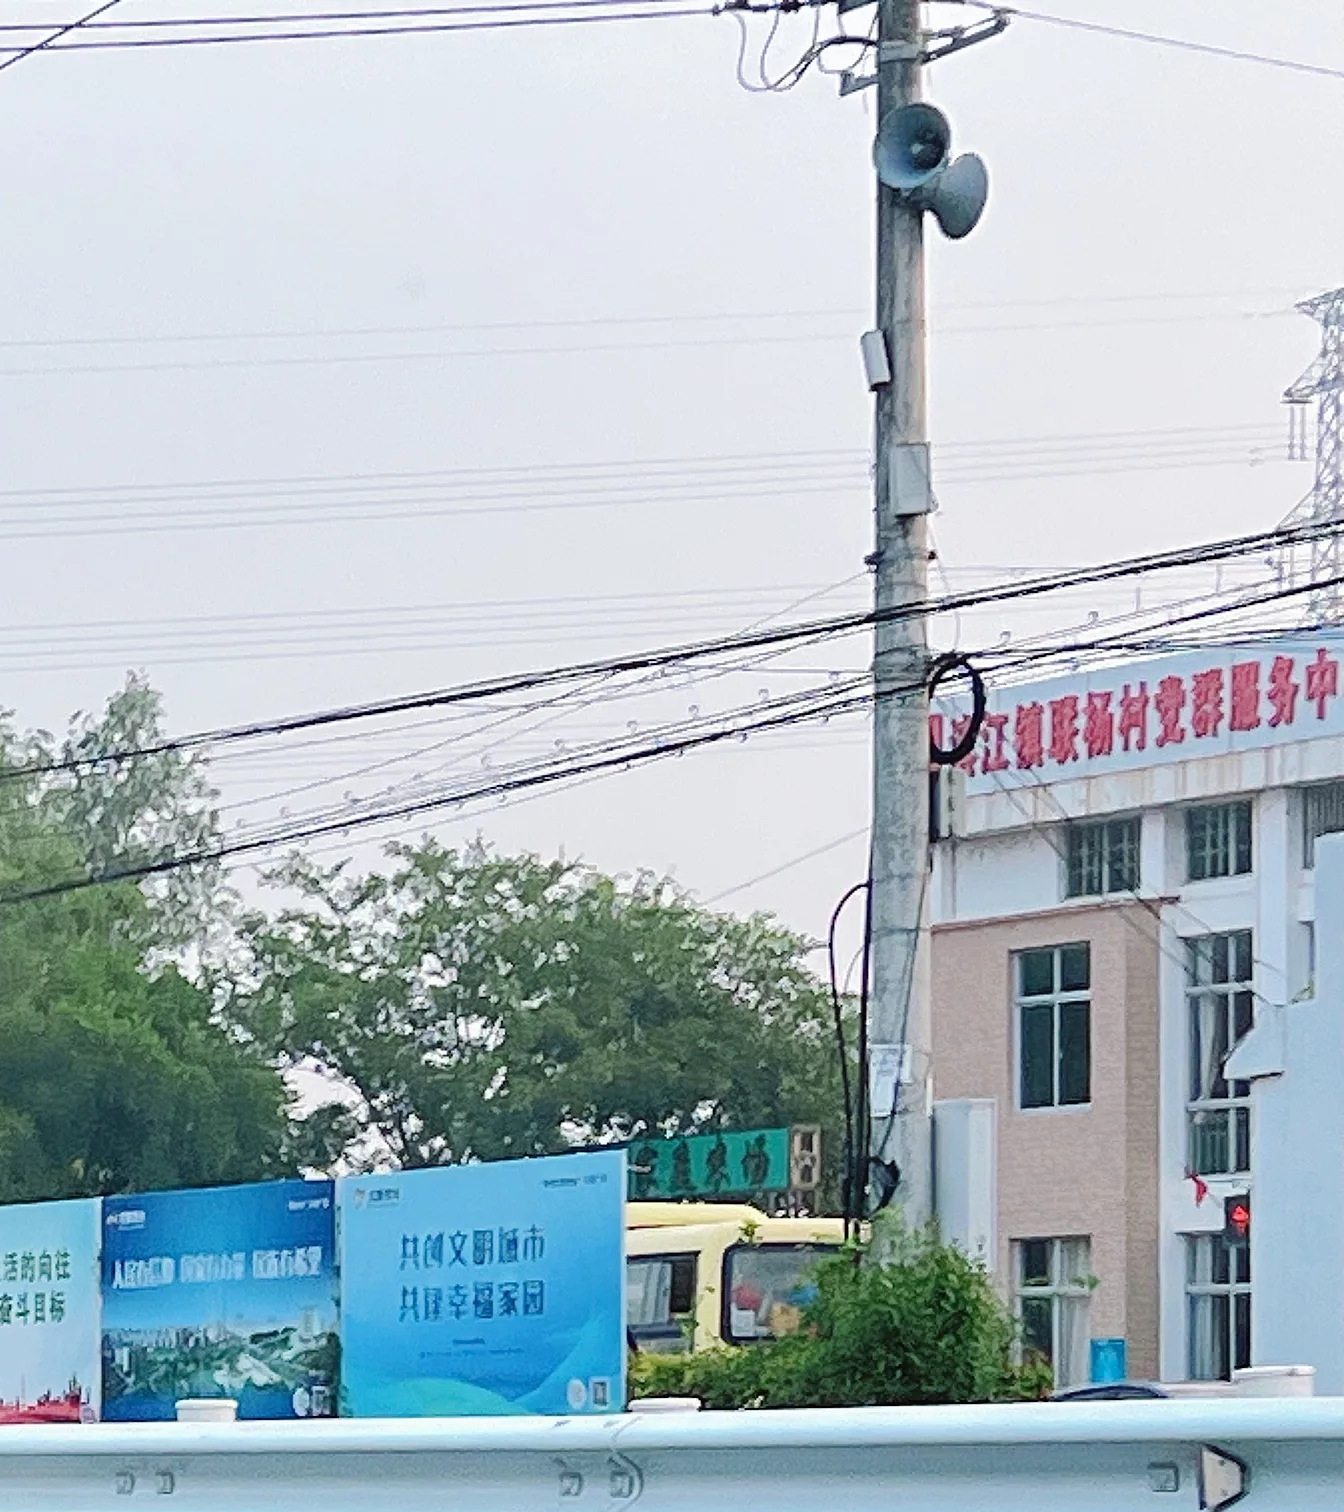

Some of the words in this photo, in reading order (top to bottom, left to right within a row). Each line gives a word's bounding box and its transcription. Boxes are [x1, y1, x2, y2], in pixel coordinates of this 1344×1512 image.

[929, 647, 1338, 777] 江镇联杨村党群服务中
